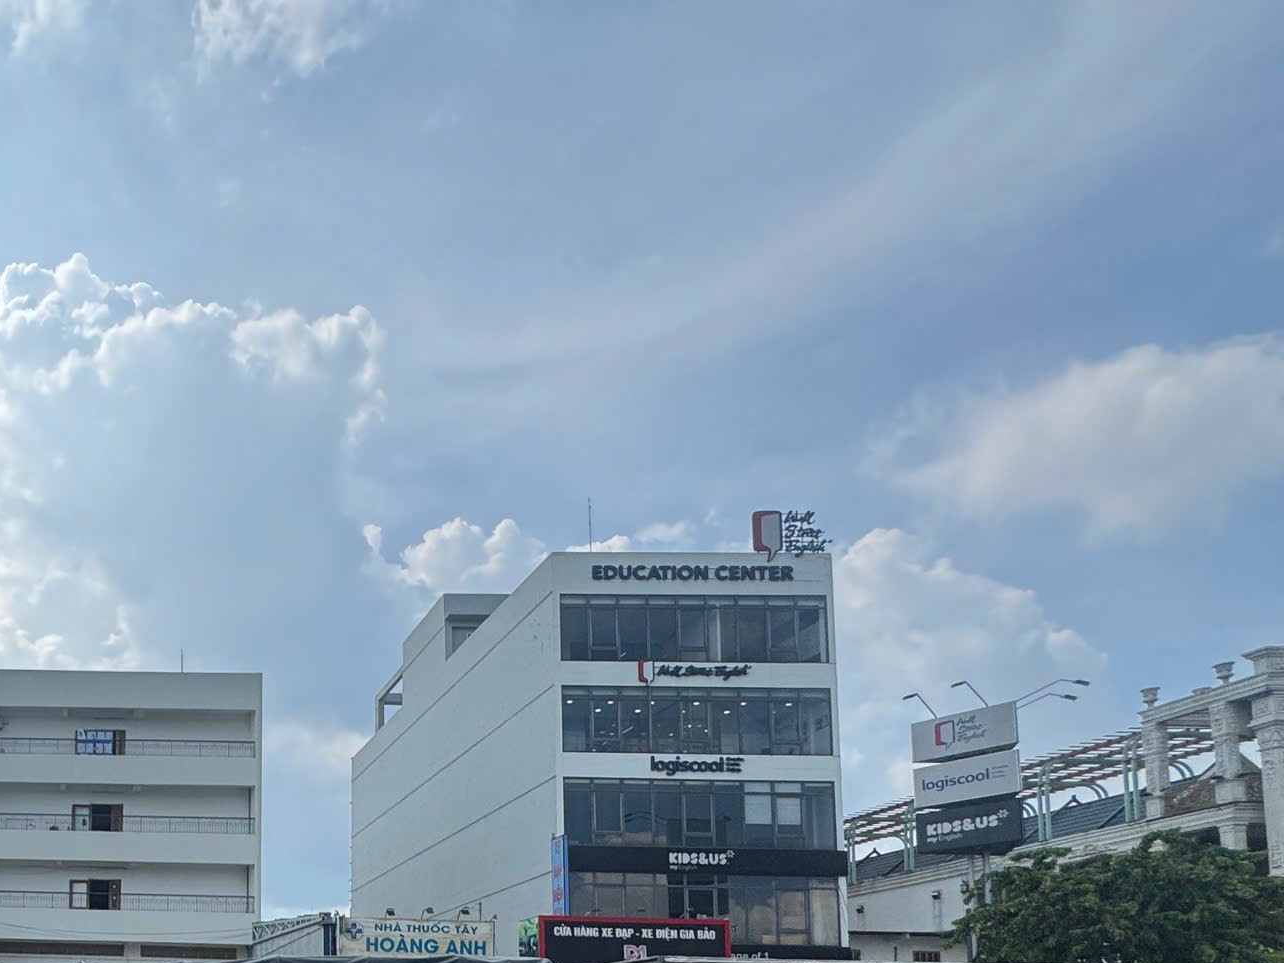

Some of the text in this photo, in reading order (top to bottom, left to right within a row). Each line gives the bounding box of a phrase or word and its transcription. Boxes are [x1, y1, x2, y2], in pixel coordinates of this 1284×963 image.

[592, 565, 794, 582] EDUCATION CENTER
[651, 756, 725, 776] logiscool
[922, 768, 990, 792] logiscool
[926, 814, 999, 836] KIDS&US
[669, 852, 727, 865] KIDS&US
[374, 920, 478, 935] NHÀ THUỐC TÂY
[553, 923, 572, 937] CỬA
[574, 925, 600, 938] HÀNG
[601, 927, 614, 938] XE
[616, 928, 634, 940] ĐẠP
[642, 928, 654, 939] XE
[656, 928, 678, 941] ĐIỆN
[680, 929, 695, 939] GIA
[698, 927, 716, 940] BẢO
[366, 934, 486, 956] HOÀNG ANH
